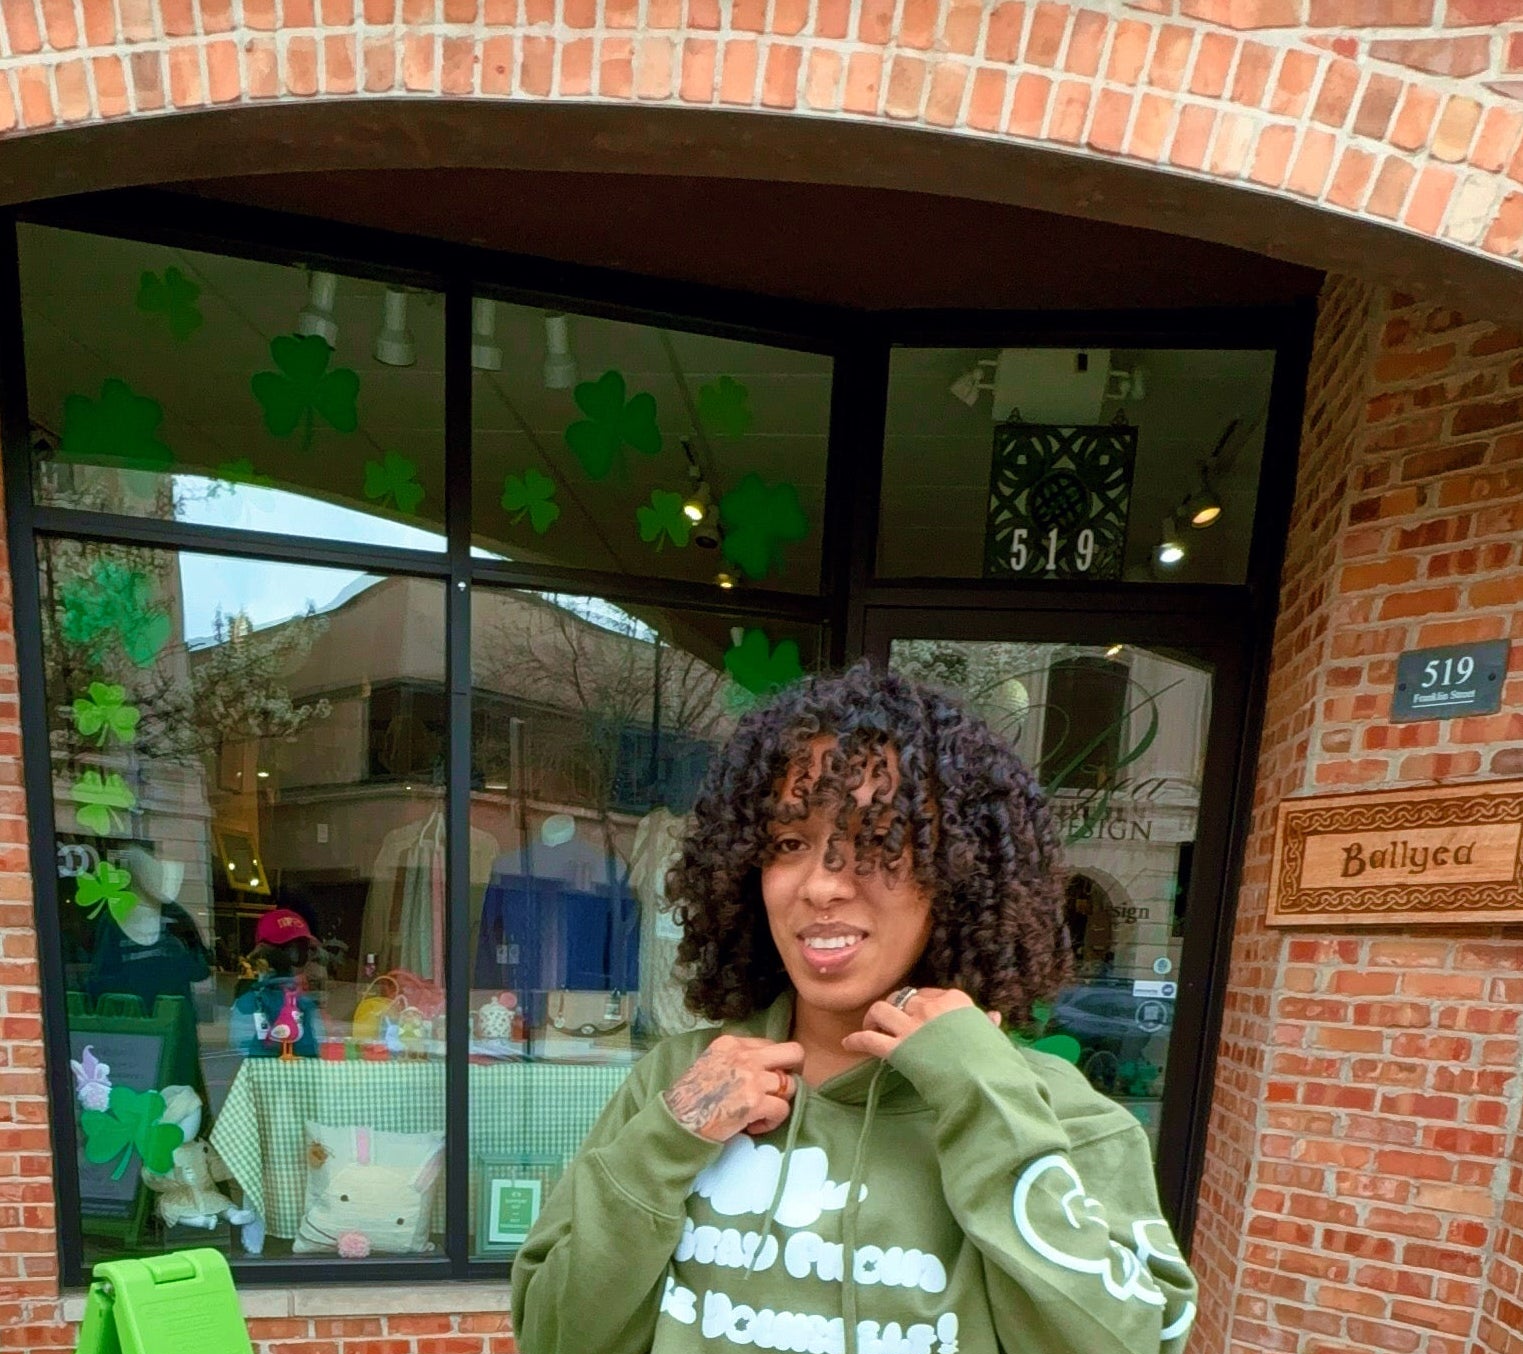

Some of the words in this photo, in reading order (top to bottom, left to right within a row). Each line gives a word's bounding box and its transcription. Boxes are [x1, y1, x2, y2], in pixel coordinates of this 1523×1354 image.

[1009, 528, 1094, 571] 519
[1421, 656, 1475, 688] 519
[1450, 689, 1476, 700] Street
[1059, 818, 1153, 841] ESIGN
